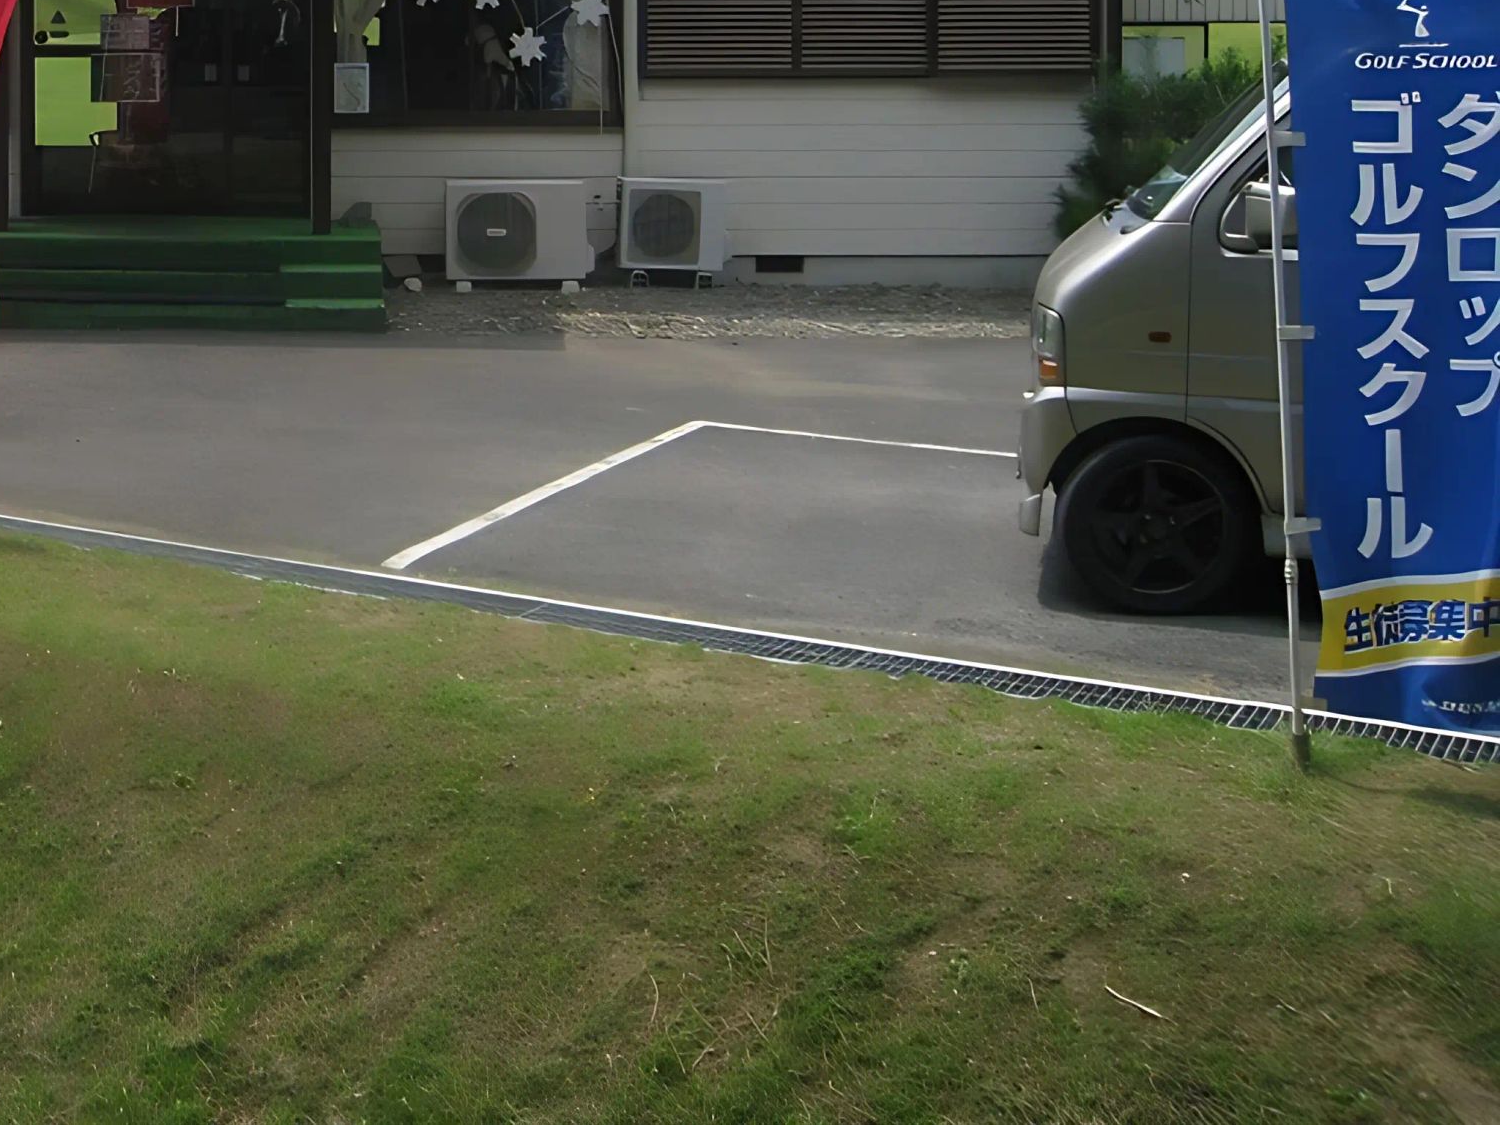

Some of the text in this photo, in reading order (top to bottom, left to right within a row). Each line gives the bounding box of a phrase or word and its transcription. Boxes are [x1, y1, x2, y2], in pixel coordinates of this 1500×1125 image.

[1354, 52, 1498, 70] GOLF SCHOOL
[1350, 90, 1434, 560] ゴルフスクール
[1437, 91, 1500, 417] ダンロップ
